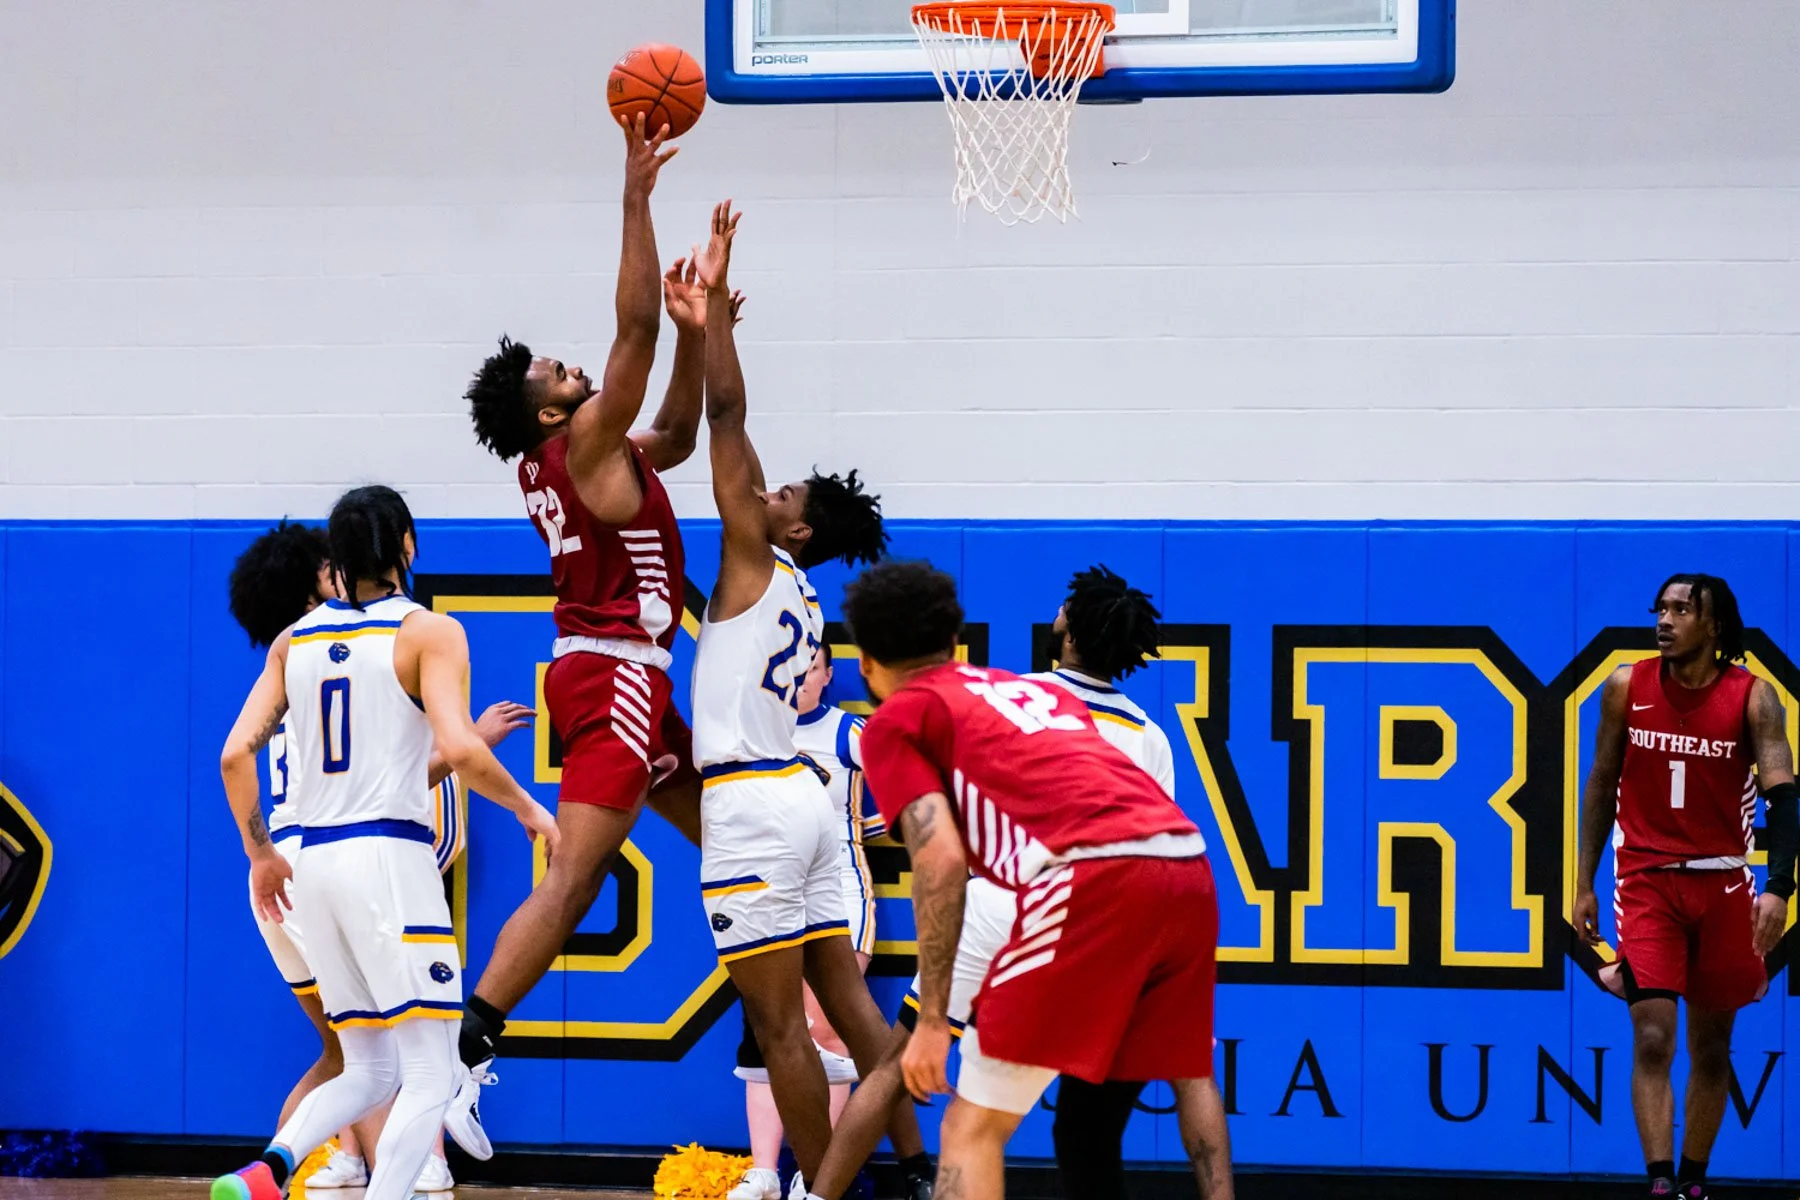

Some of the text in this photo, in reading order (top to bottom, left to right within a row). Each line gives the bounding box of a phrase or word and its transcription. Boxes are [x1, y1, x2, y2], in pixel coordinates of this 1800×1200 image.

[319, 675, 352, 776] 0
[964, 680, 1087, 735] 12
[1628, 726, 1737, 759] SOUTHEAST
[1668, 760, 1686, 809] 1
[1419, 1042, 1786, 1130] UNV
